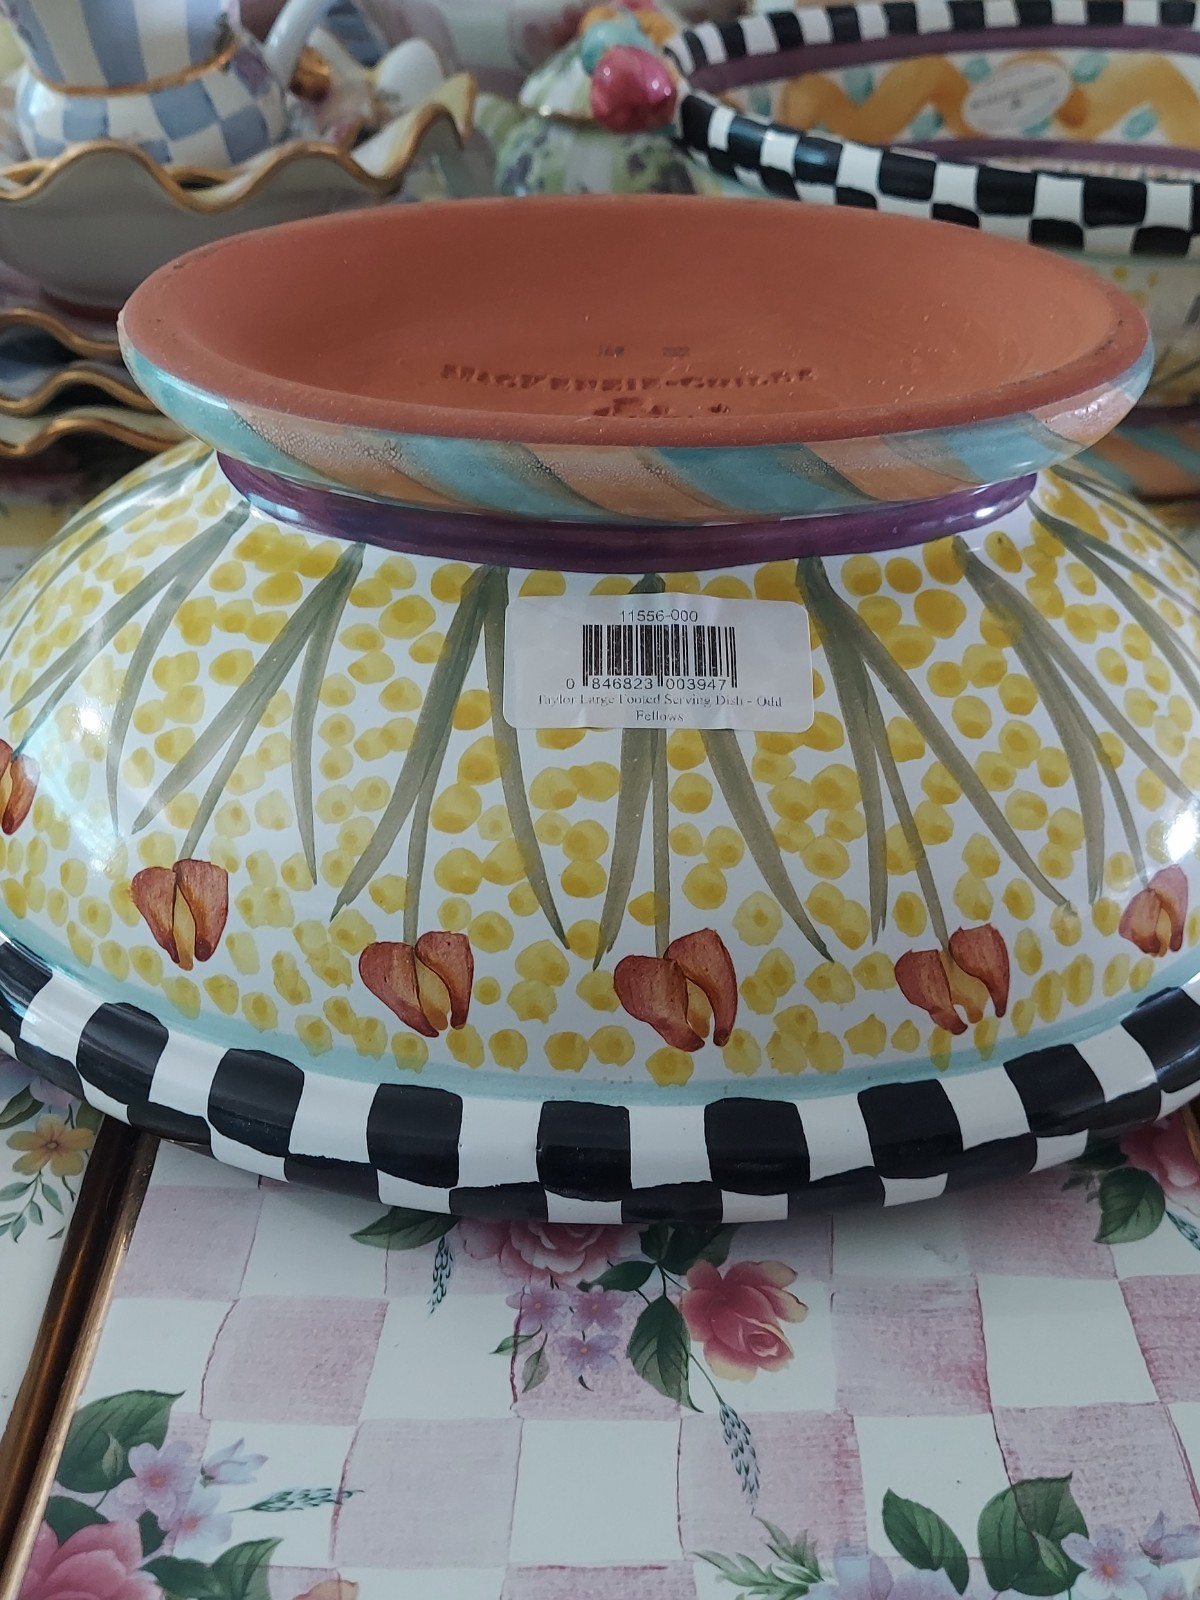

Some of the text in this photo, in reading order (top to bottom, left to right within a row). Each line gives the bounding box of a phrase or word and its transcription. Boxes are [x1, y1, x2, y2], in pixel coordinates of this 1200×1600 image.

[620, 609, 699, 623] 11556-000
[566, 678, 727, 690] 0 846823 003947
[580, 694, 615, 707] Large
[664, 694, 711, 708] Serving
[715, 695, 744, 706] Dish
[756, 696, 783, 708] Odd
[636, 709, 684, 722] Fellows
